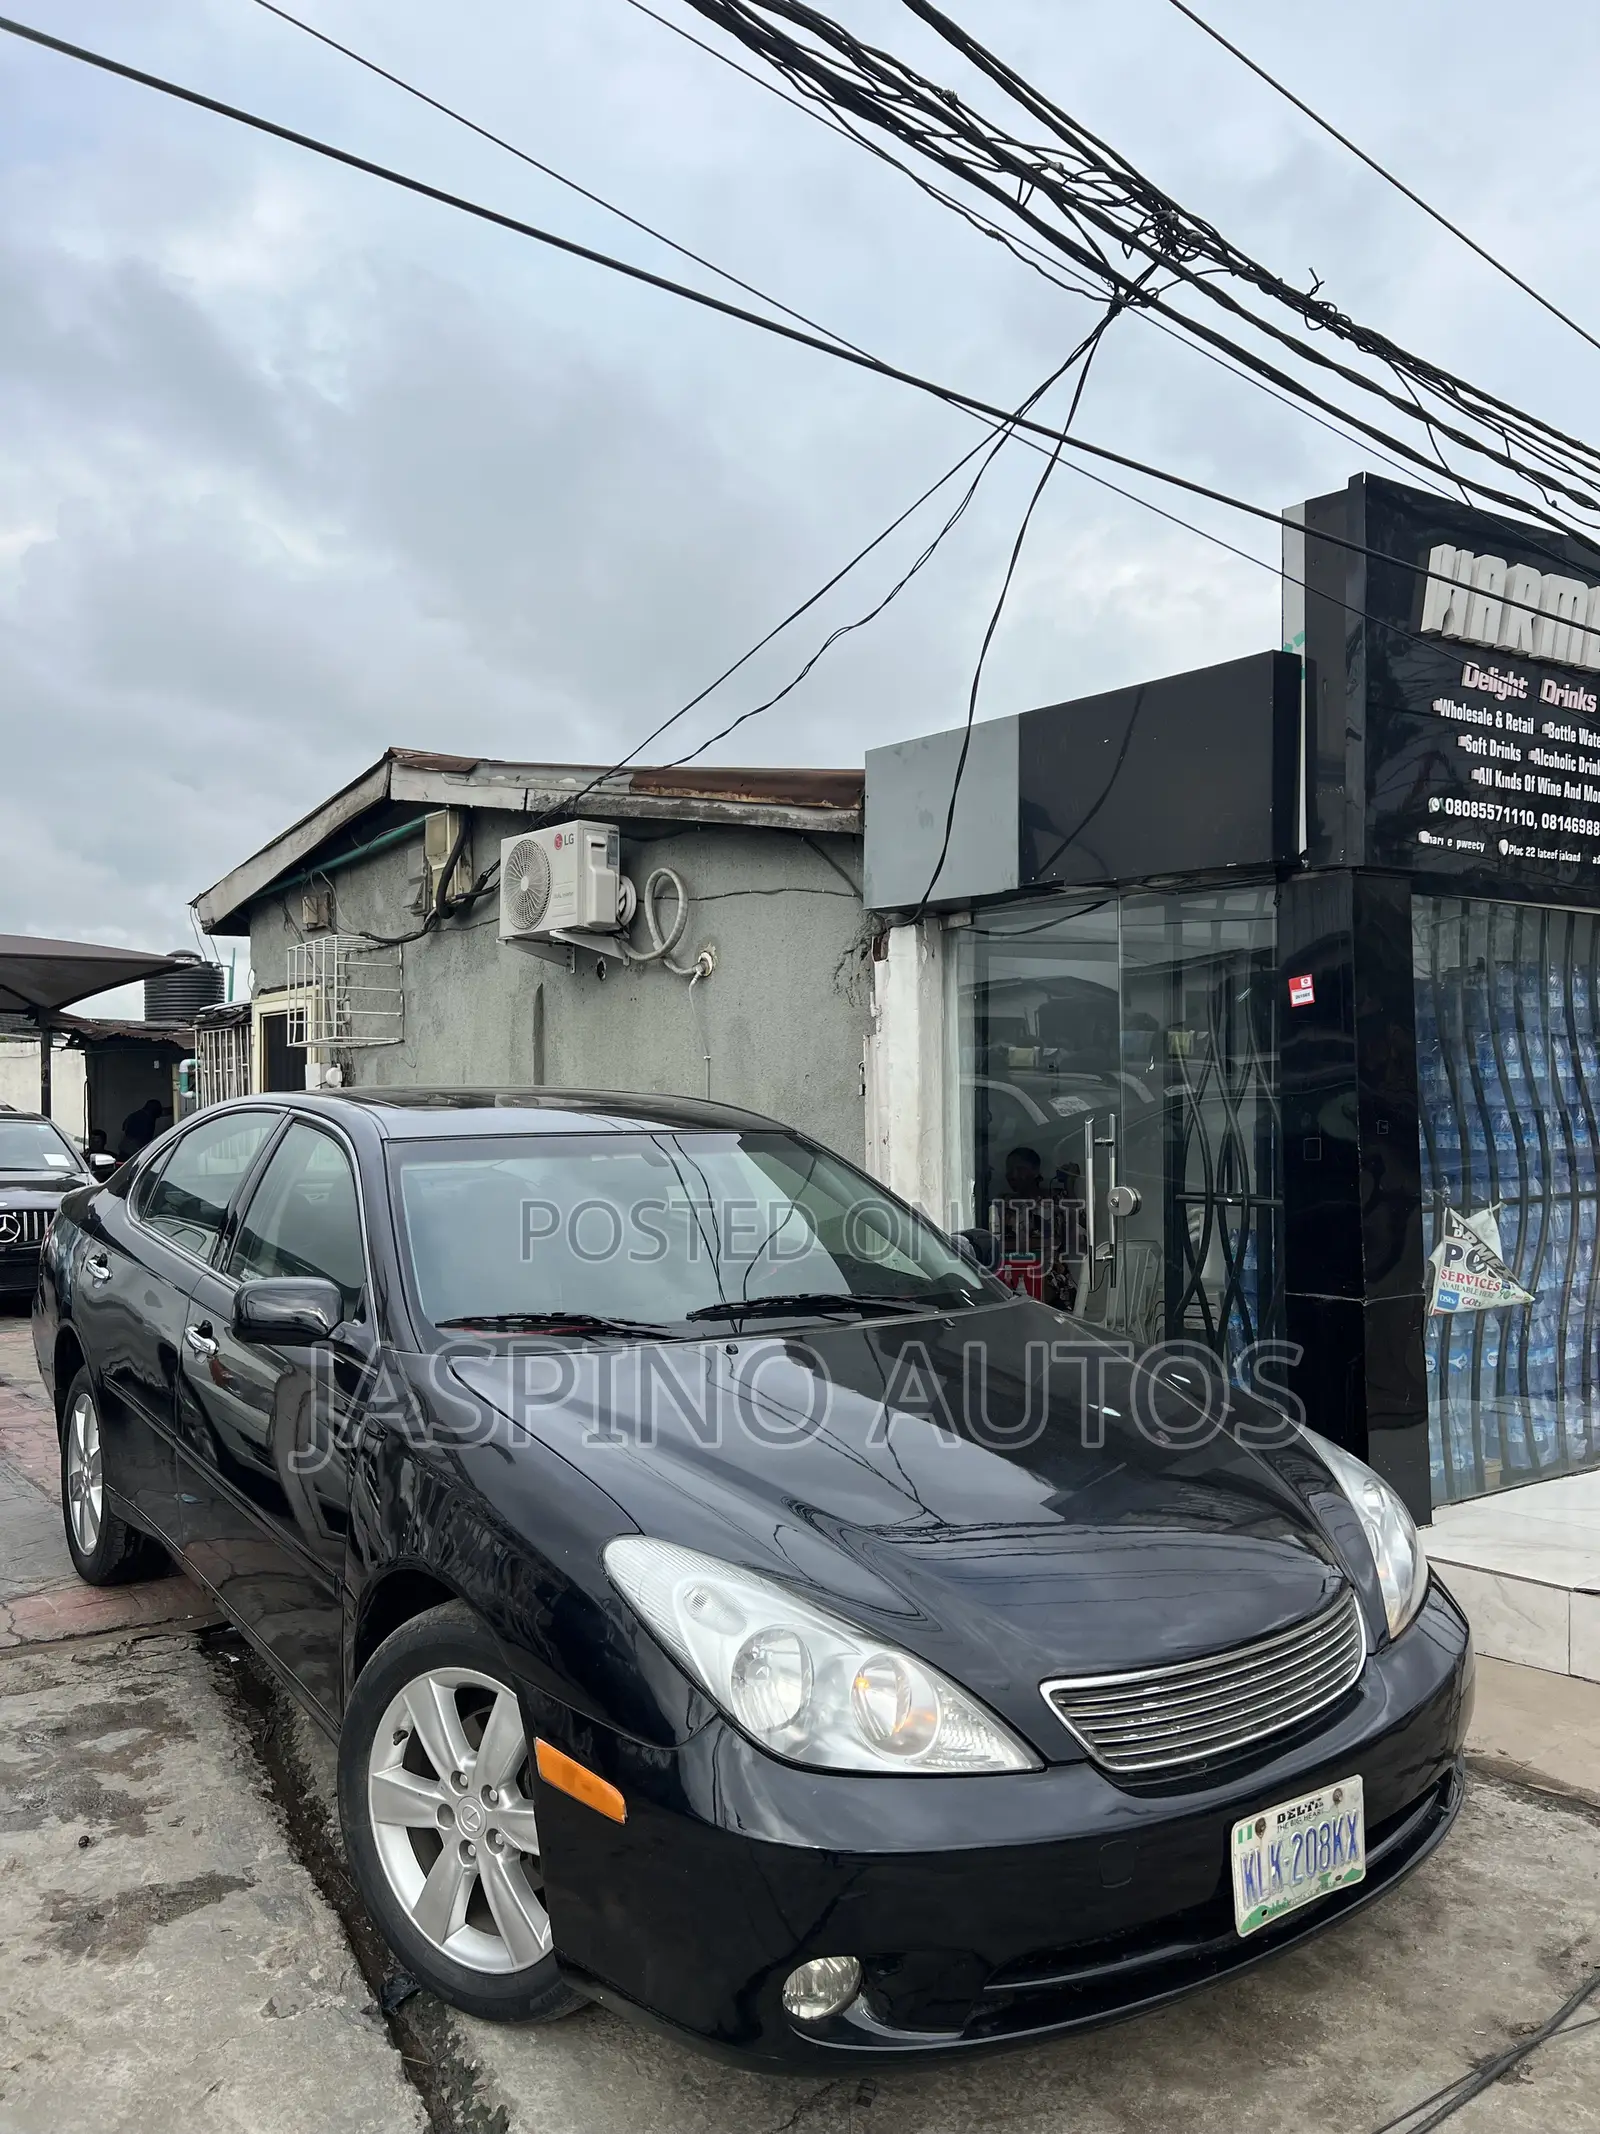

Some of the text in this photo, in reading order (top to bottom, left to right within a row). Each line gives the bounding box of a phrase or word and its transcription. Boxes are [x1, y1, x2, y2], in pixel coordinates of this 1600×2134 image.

[1461, 661, 1597, 712] Delight Drinks
[1440, 698, 1534, 735] Wholesale & Retail
[1548, 721, 1577, 743] Bottle
[1465, 734, 1521, 762] Soft Drinks
[1534, 748, 1577, 772] Alcoholic
[1478, 766, 1493, 787] All
[1524, 774, 1536, 793] Of
[1537, 776, 1562, 797] Wine
[1563, 780, 1582, 801] And
[1445, 797, 1538, 829] 08085571110,
[564, 833, 574, 846] LG
[1508, 844, 1524, 857] Plot
[1525, 846, 1536, 858] 22
[1440, 1269, 1501, 1292] SERVICES
[1441, 1282, 1479, 1295] AVAILABLE
[1480, 1288, 1495, 1299] HERE
[1277, 1797, 1324, 1825] DELTA
